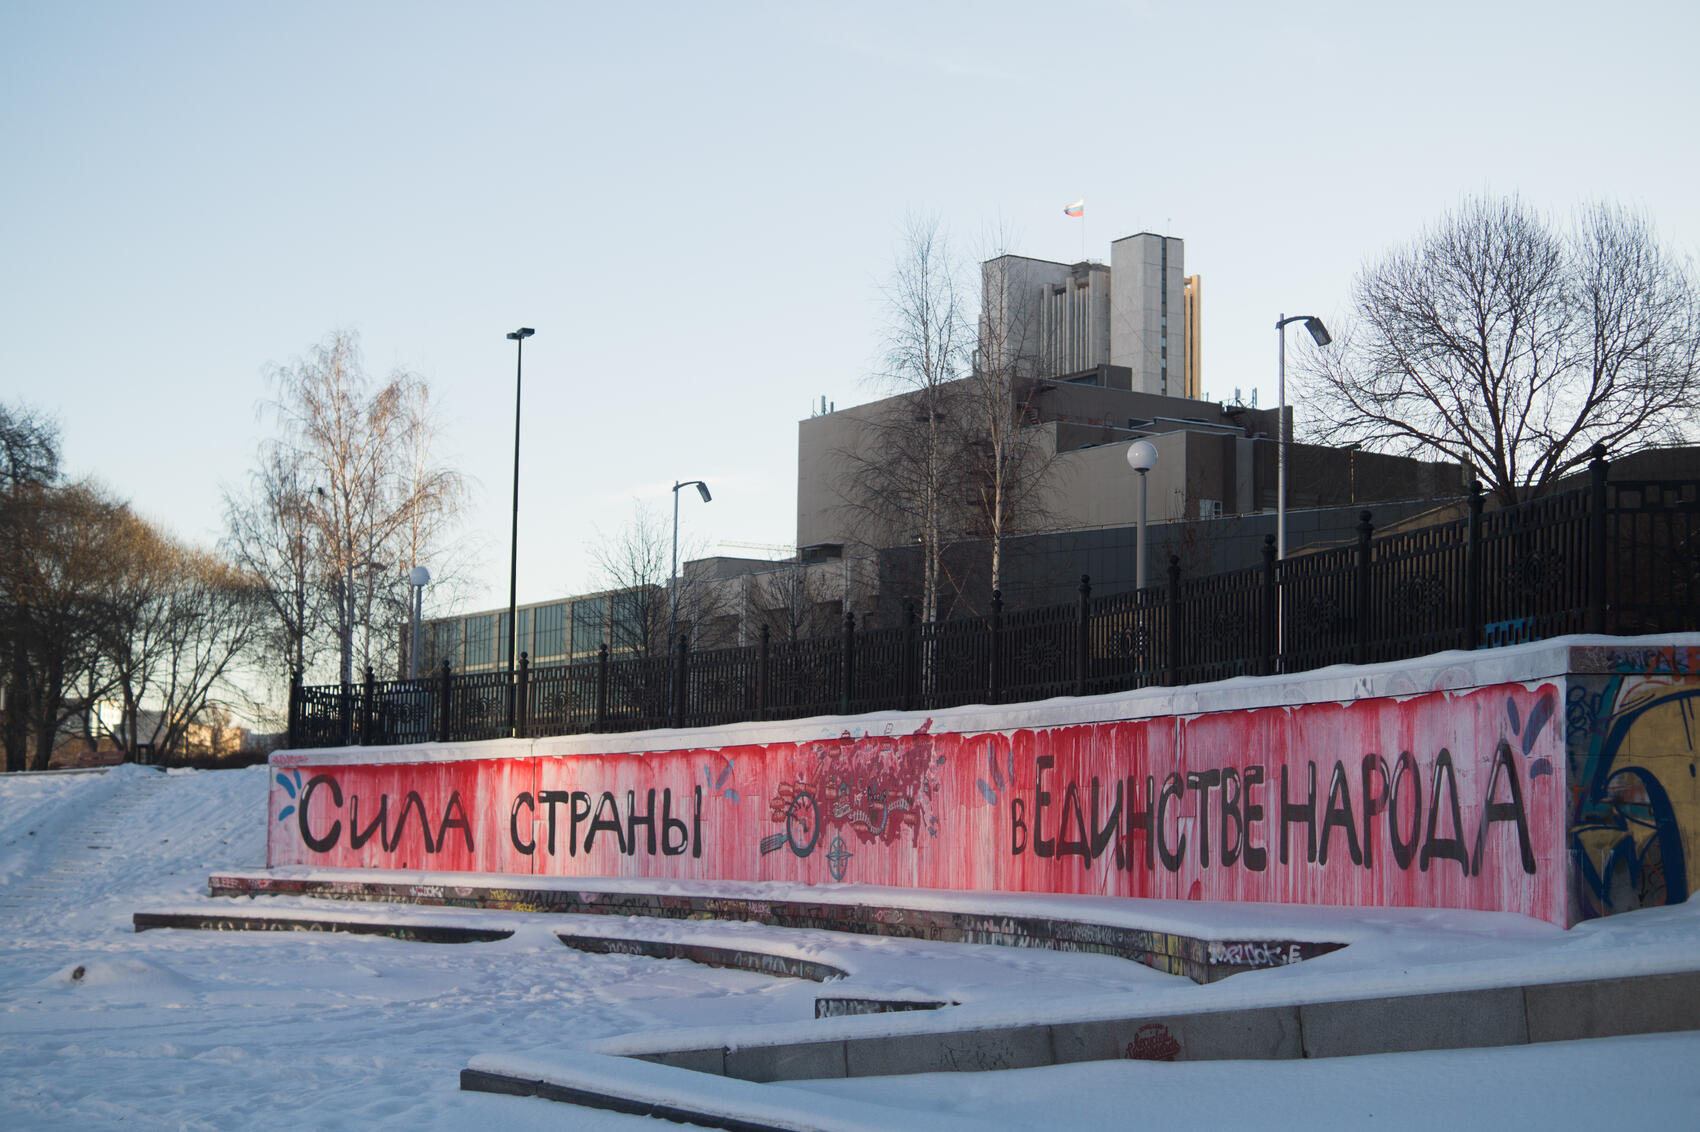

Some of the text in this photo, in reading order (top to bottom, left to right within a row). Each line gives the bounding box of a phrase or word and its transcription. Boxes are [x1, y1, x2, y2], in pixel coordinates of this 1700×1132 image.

[511, 785, 702, 857] СТРАНЫ
[1034, 755, 1268, 872] ЕДИНСТВЕ
[1279, 740, 1537, 877] НАРОДА
